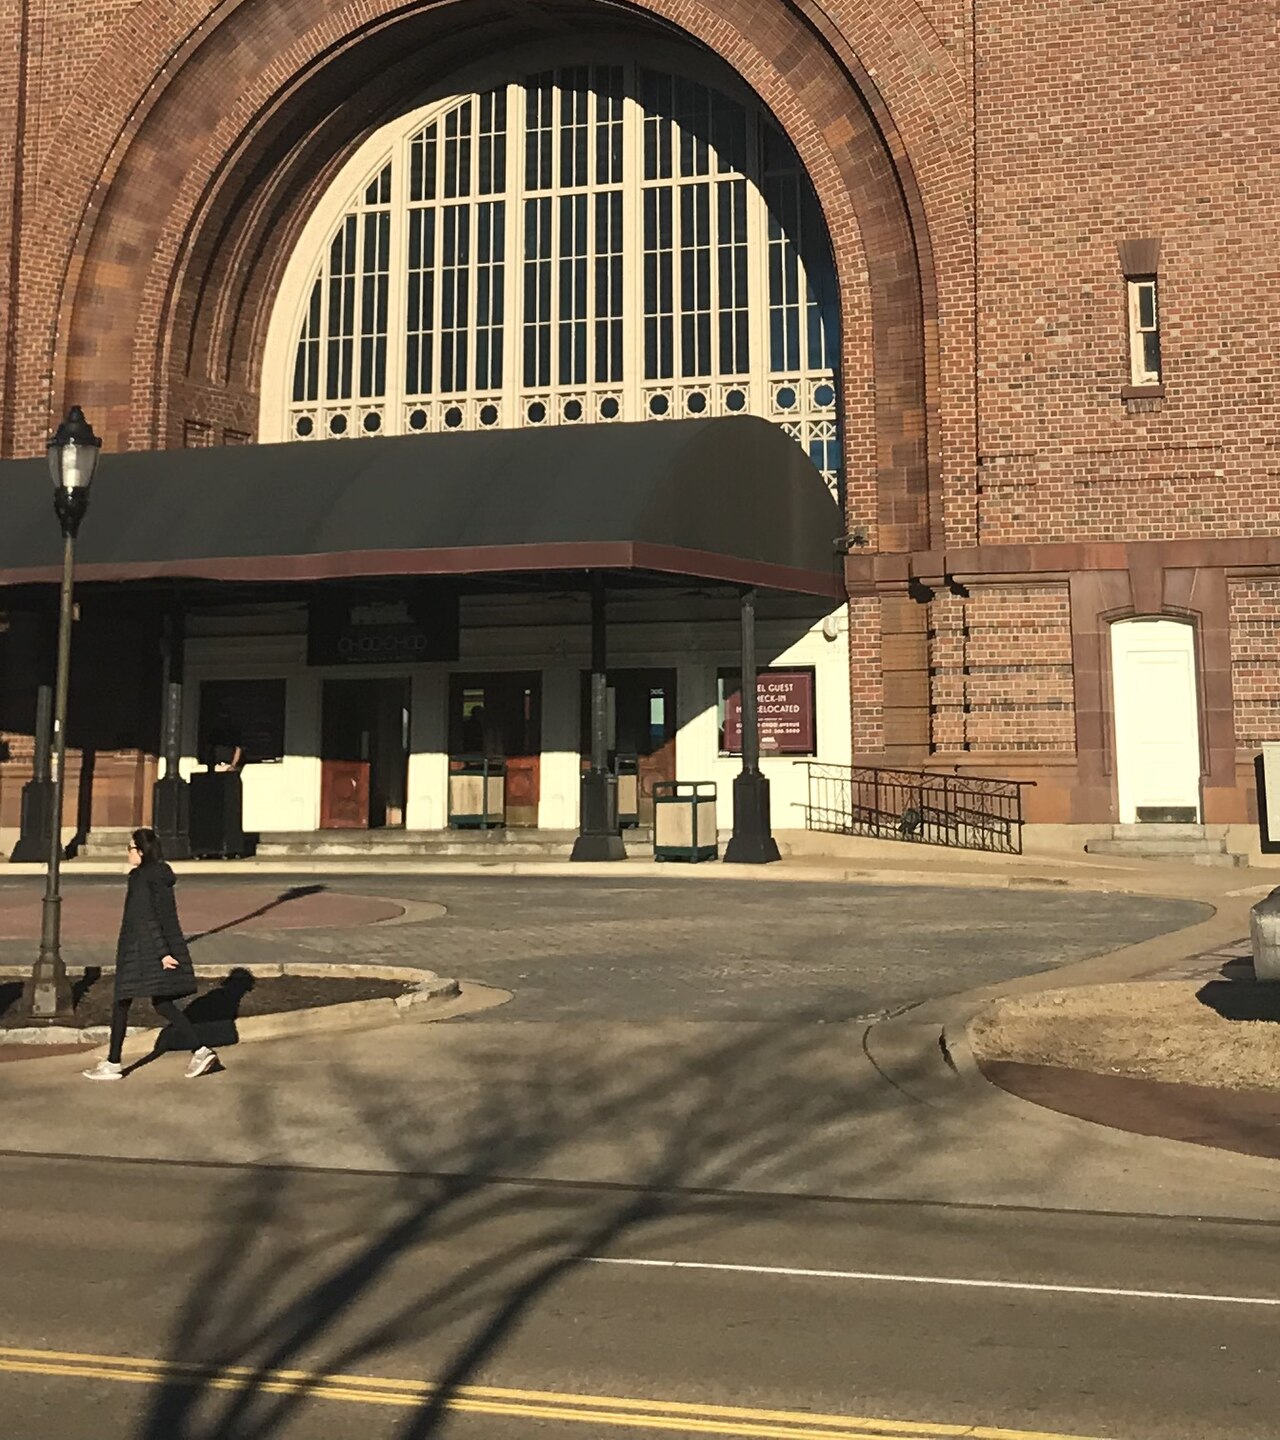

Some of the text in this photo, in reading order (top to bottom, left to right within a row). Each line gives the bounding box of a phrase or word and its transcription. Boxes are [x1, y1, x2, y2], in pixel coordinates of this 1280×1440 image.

[768, 683, 794, 692] GUEST
[757, 694, 786, 703] ECK-IN
[757, 705, 800, 713] ELOCATED
